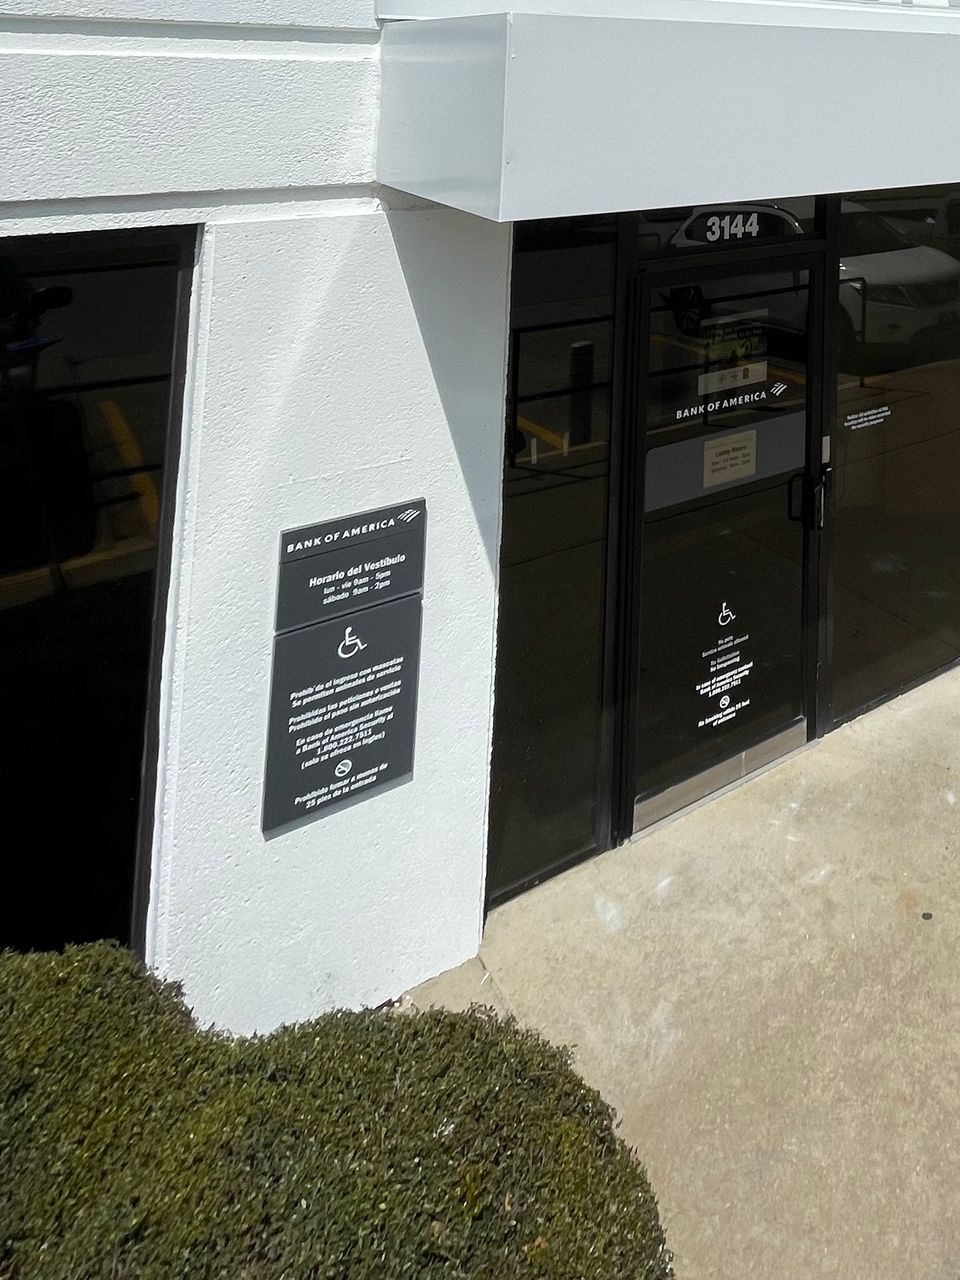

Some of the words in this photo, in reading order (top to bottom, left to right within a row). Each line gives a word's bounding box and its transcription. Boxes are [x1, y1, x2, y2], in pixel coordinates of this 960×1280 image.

[706, 212, 760, 242] 3144
[676, 404, 706, 420] BANK
[707, 400, 721, 412] OF
[722, 391, 767, 409] AMERICA
[287, 536, 322, 553] BANK
[324, 531, 340, 542] OF
[342, 518, 395, 538] AMERICA
[309, 570, 345, 587] Horario
[346, 564, 362, 576] del
[364, 554, 405, 571] Vestíbulo
[352, 586, 368, 596] 9am
[374, 580, 390, 589] 2pm
